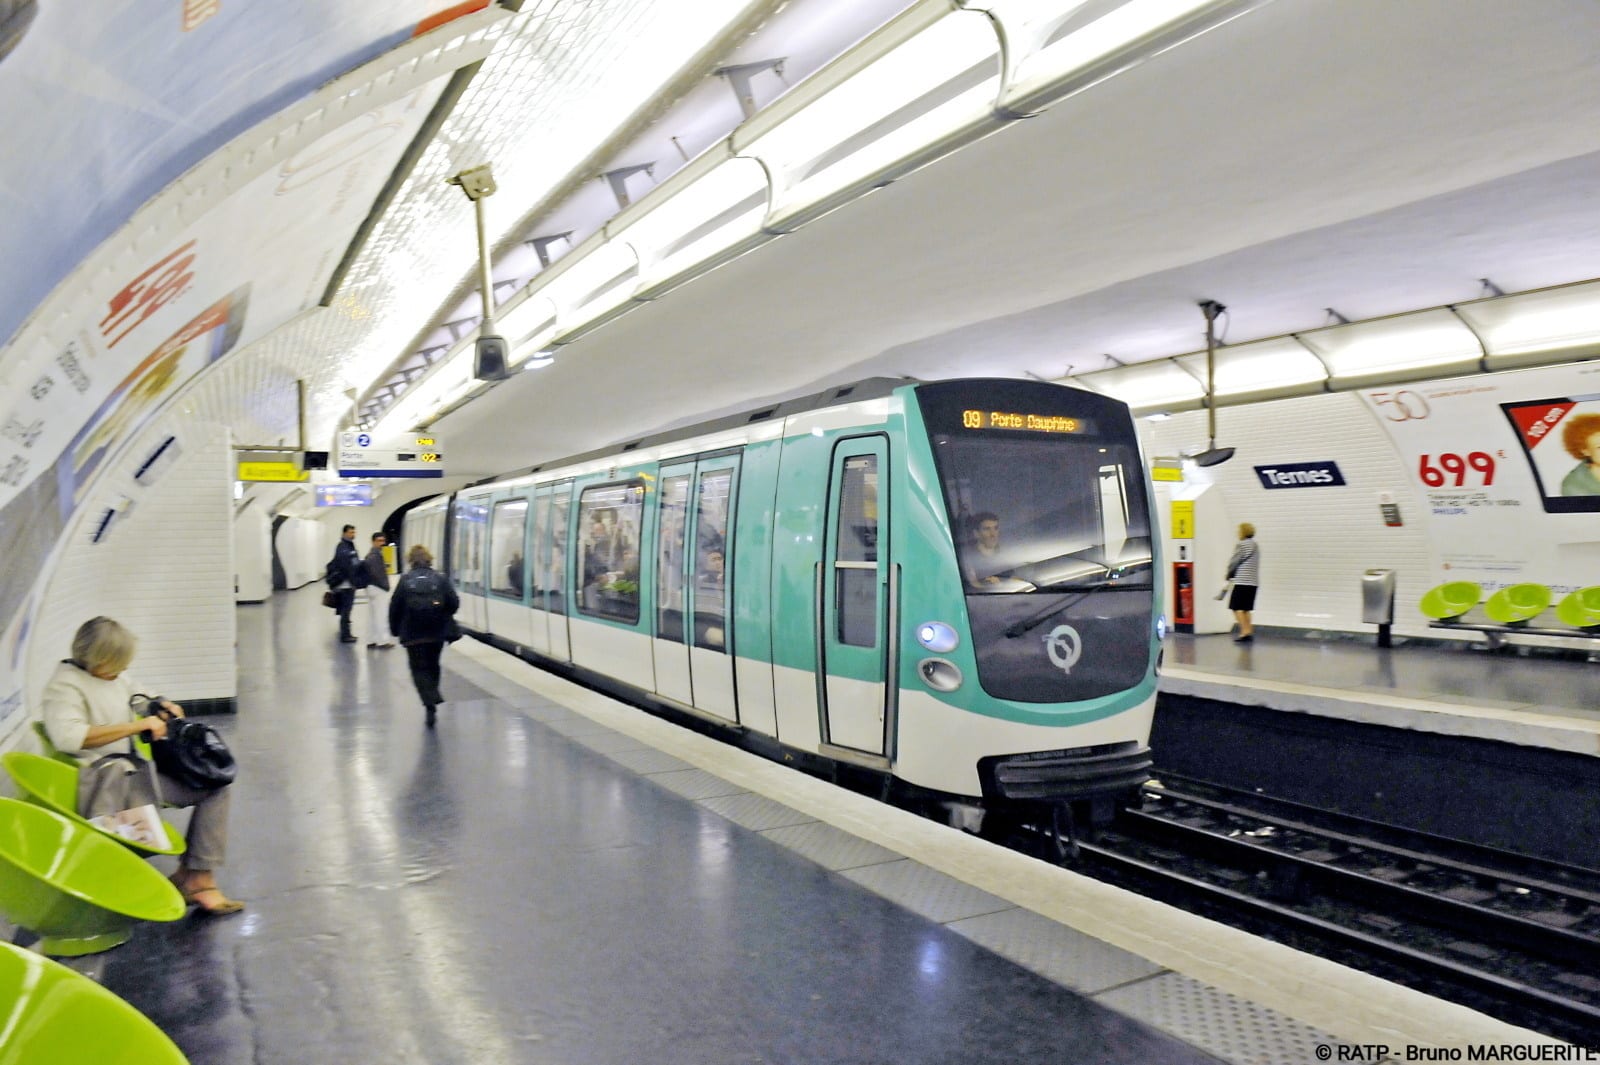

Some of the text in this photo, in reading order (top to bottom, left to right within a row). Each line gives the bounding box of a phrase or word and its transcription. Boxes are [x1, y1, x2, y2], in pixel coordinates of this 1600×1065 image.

[1369, 390, 1430, 422] 50
[1544, 407, 1565, 423] cm
[962, 410, 1076, 433] 09 Porte Dauphine
[1419, 451, 1496, 488] 699
